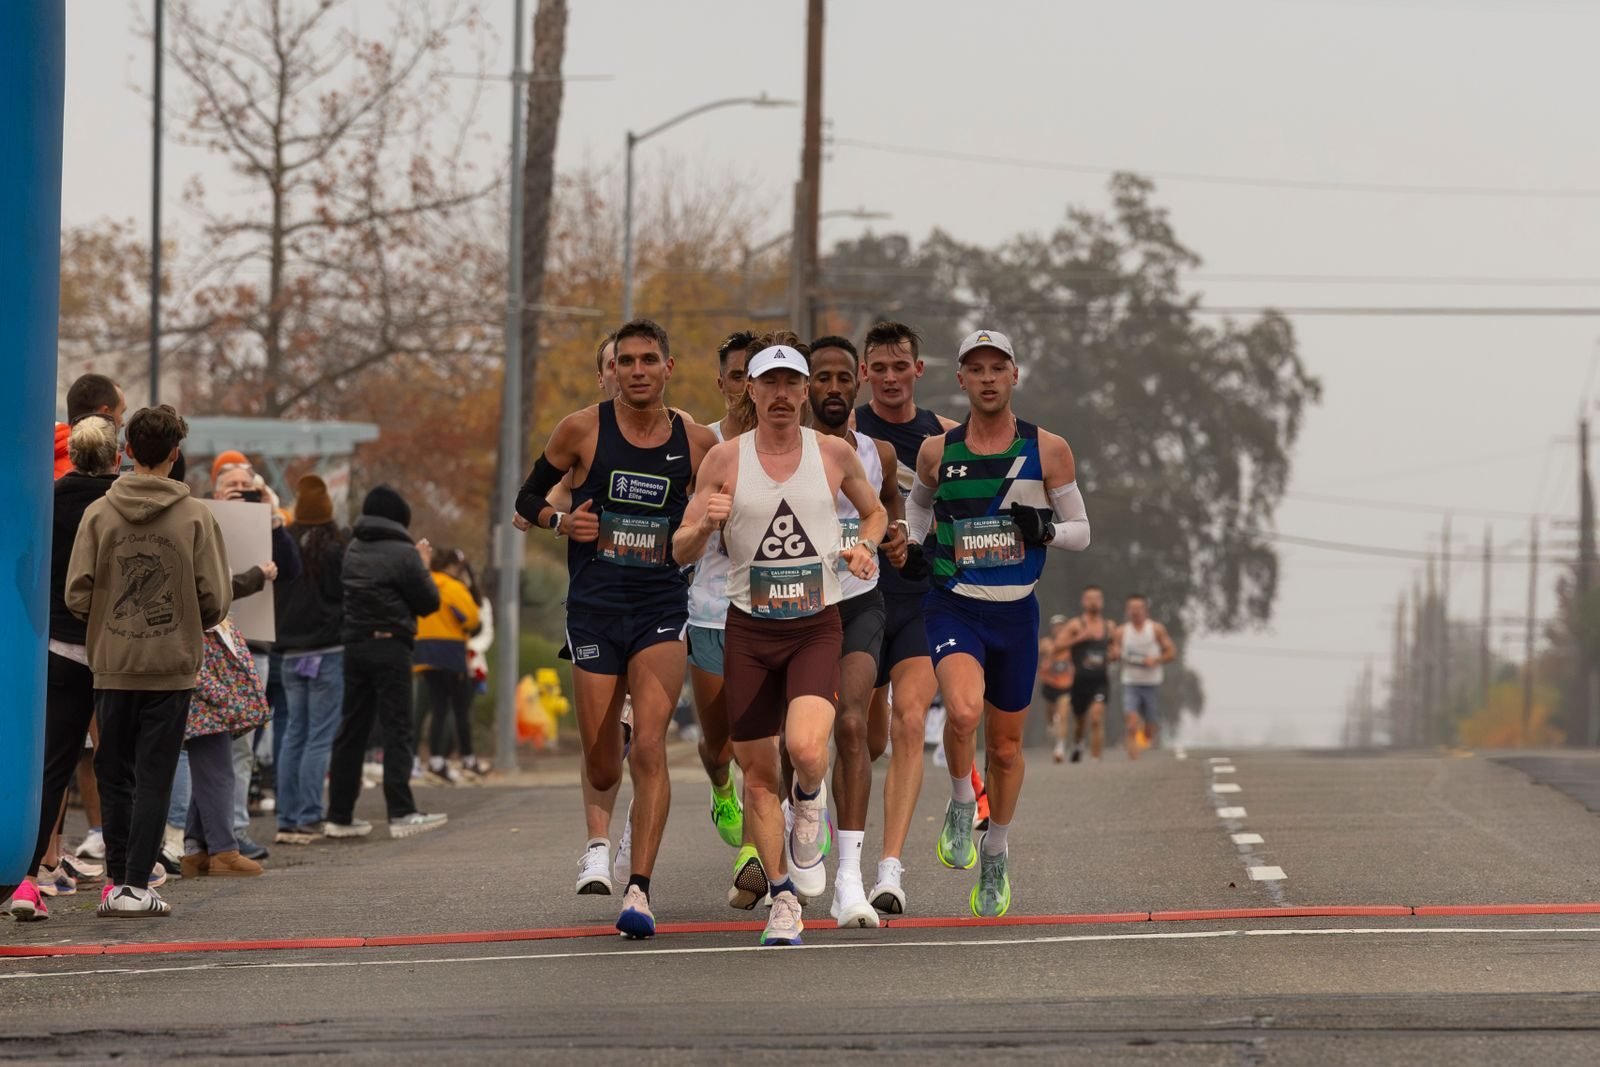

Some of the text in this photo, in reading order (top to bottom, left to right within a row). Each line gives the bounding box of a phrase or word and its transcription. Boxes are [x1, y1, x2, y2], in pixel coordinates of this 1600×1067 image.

[629, 486, 658, 496] Distance
[630, 479, 664, 491] Minnesota
[628, 492, 643, 500] Elite
[612, 530, 656, 549] TROJAN
[962, 532, 1015, 550] THOMSON
[768, 582, 805, 599] ALLEN
